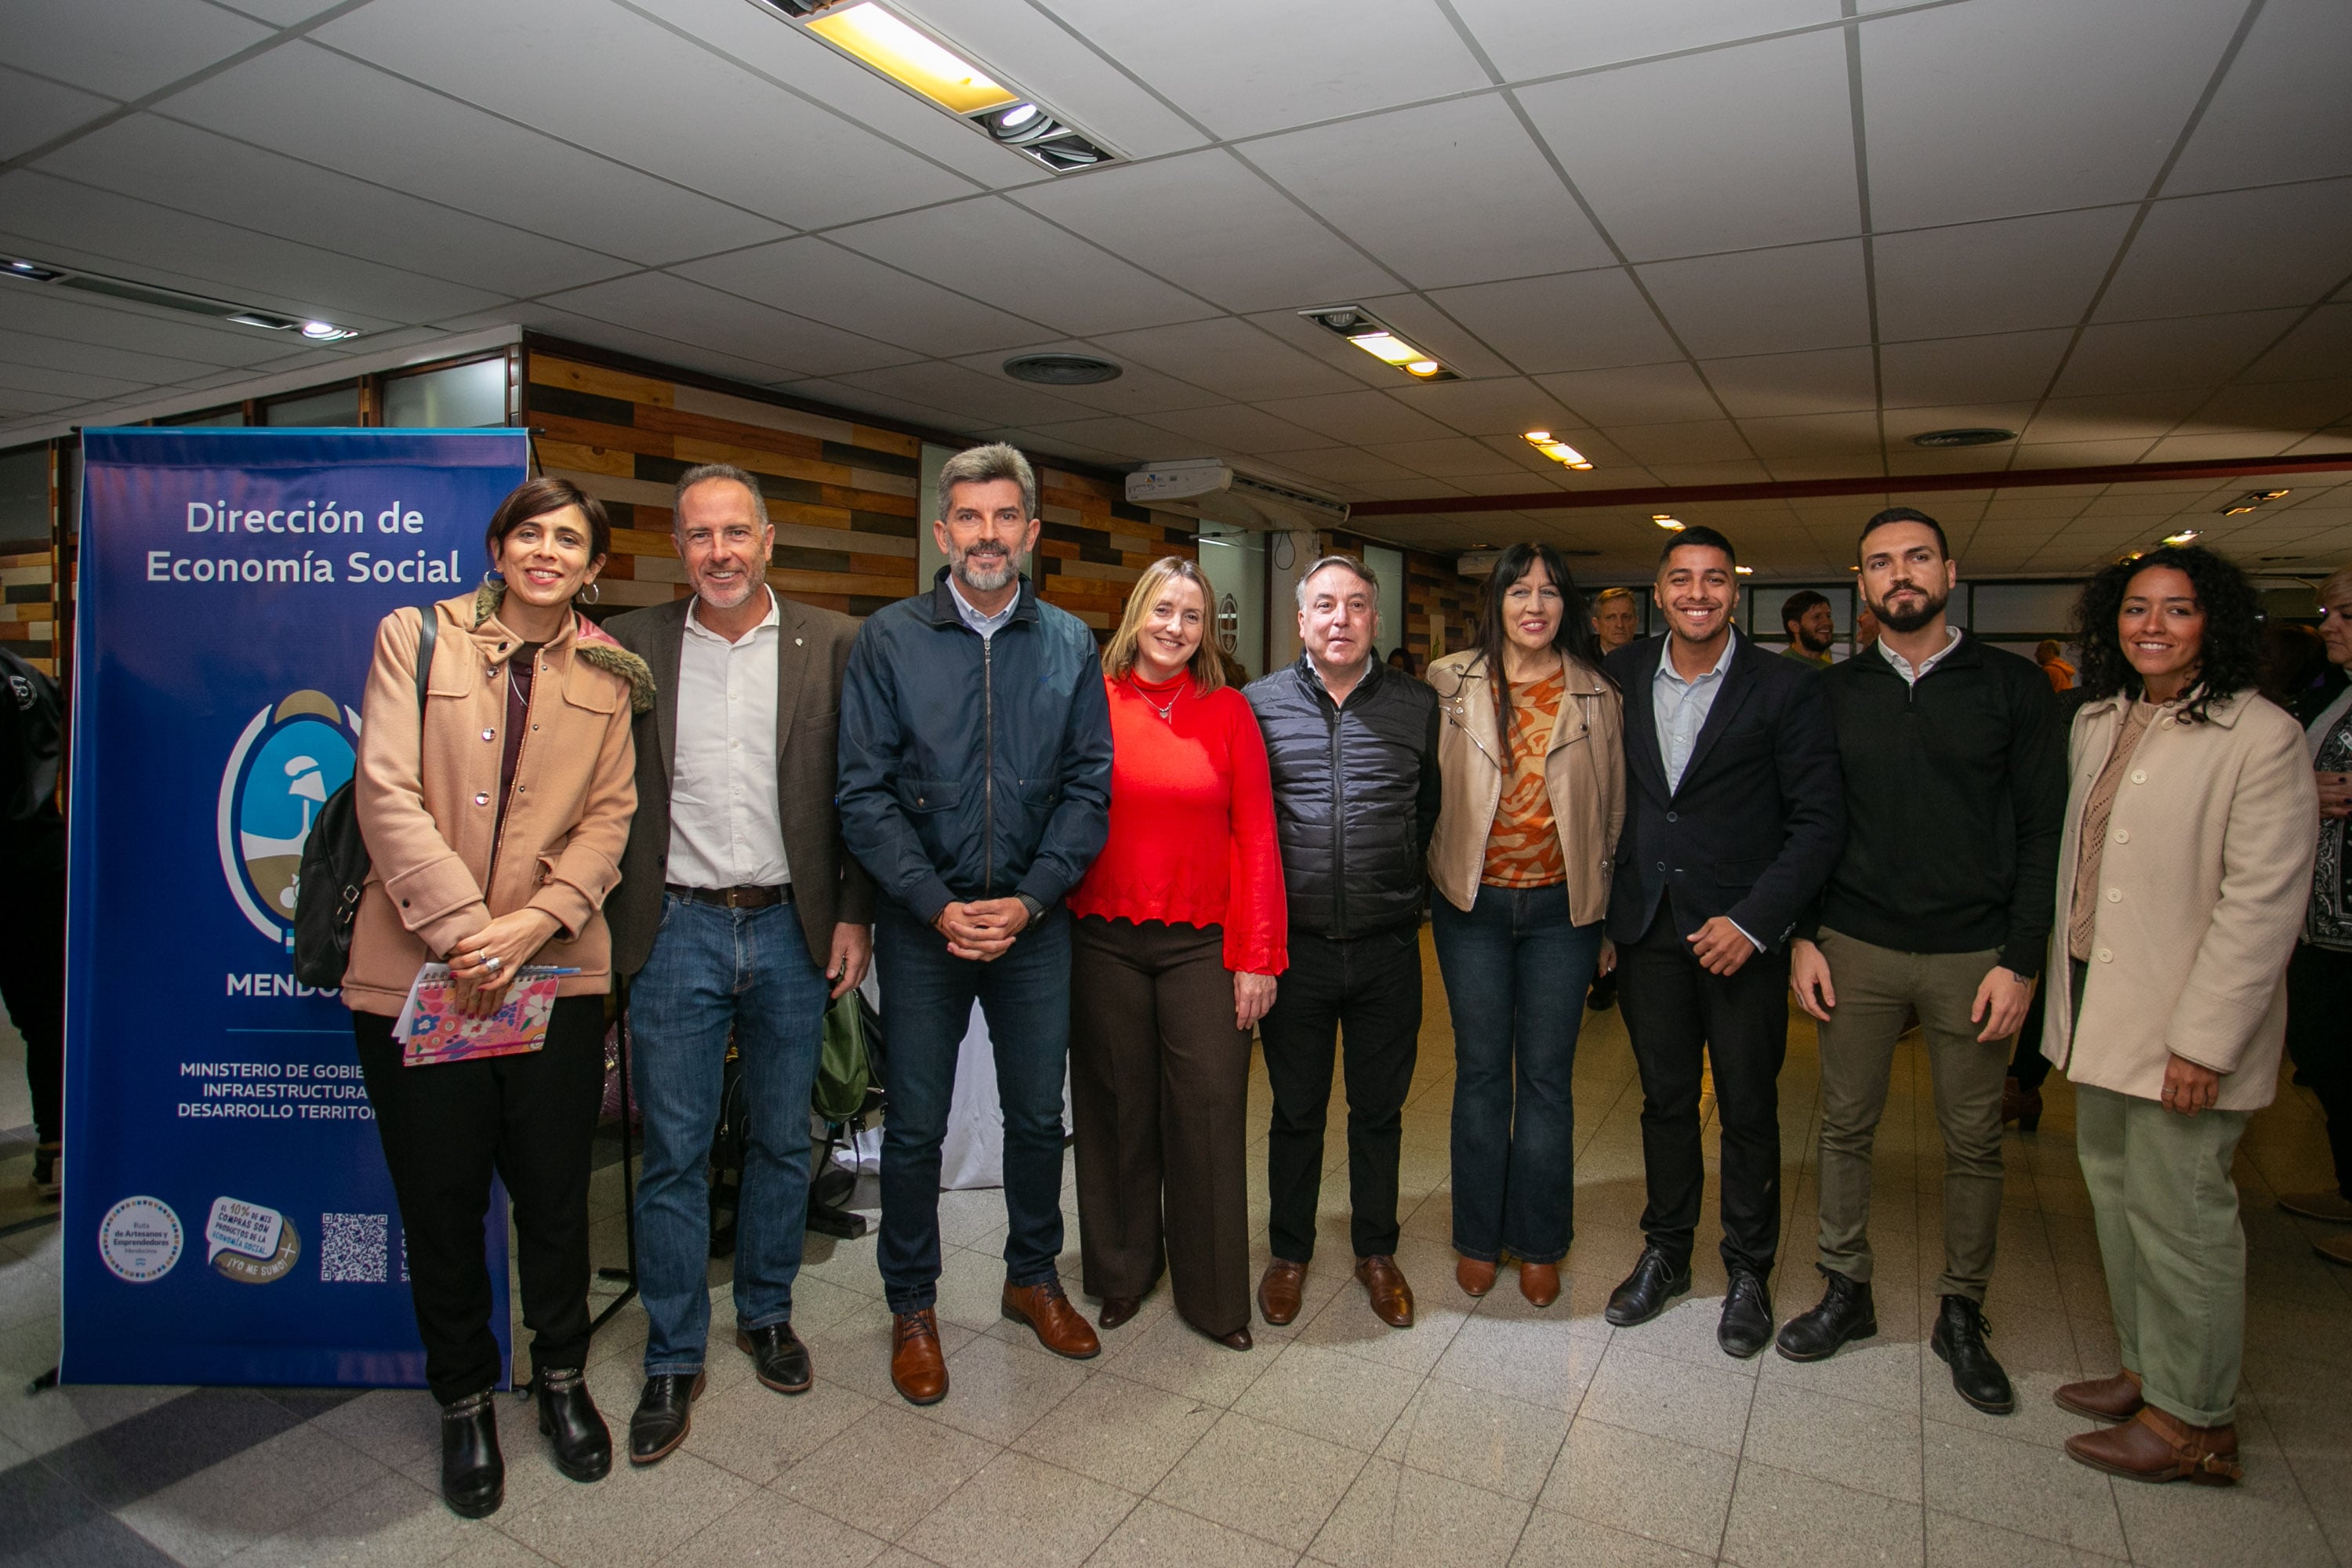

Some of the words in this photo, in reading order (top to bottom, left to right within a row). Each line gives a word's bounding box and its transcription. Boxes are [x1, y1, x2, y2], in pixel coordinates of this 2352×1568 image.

[187, 500, 364, 533] Dirección
[378, 501, 423, 533] de
[147, 550, 334, 583] Economía
[347, 550, 461, 583] Social
[227, 974, 343, 997] MEND
[181, 1063, 281, 1078] MINISTERIO
[285, 1065, 309, 1078] DE
[314, 1065, 364, 1079] GOBIE
[204, 1083, 368, 1099] INFRAESTRUCTURA
[178, 1103, 293, 1118] DESARROLLO
[230, 1203, 250, 1217] 10%
[218, 1213, 251, 1229] COMPRAS
[253, 1223, 270, 1233] SON
[212, 1231, 242, 1247] ECONOMÍA
[216, 1222, 249, 1238] PRODUCTOS
[258, 1235, 266, 1243] LA
[246, 1264, 259, 1275] ME
[260, 1258, 288, 1276] SUMO!
